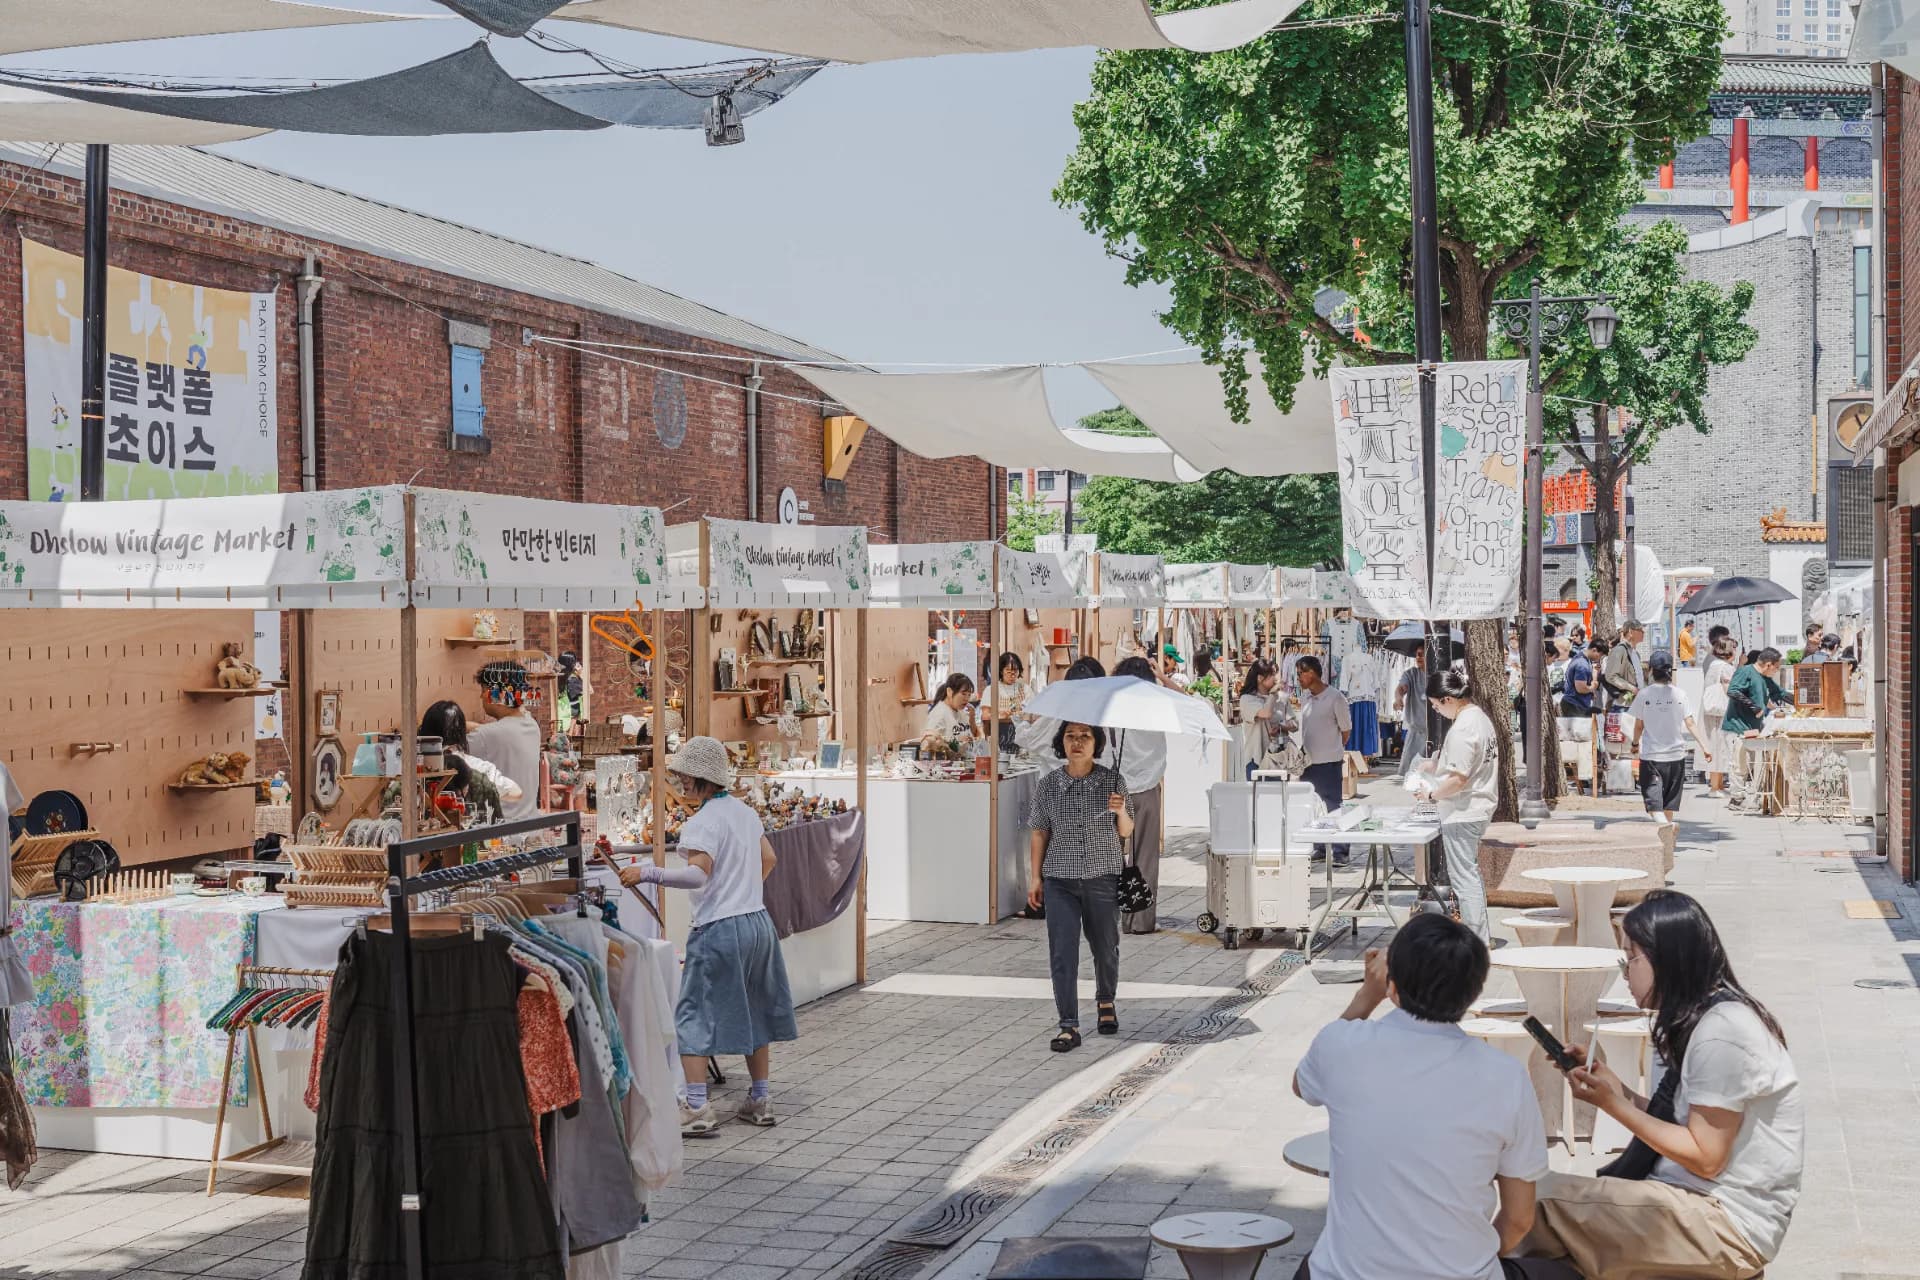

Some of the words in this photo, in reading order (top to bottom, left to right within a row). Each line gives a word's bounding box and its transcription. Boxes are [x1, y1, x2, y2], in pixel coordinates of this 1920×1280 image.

[107, 352, 214, 416] 플랫폼
[106, 412, 216, 471] 초이스
[116, 528, 204, 560] Vintage
[213, 523, 298, 553] Market
[502, 528, 552, 563] 만만한
[555, 530, 596, 563] 빈티지
[776, 546, 806, 571] Vintage
[807, 547, 835, 567] Market
[872, 559, 924, 577] Market
